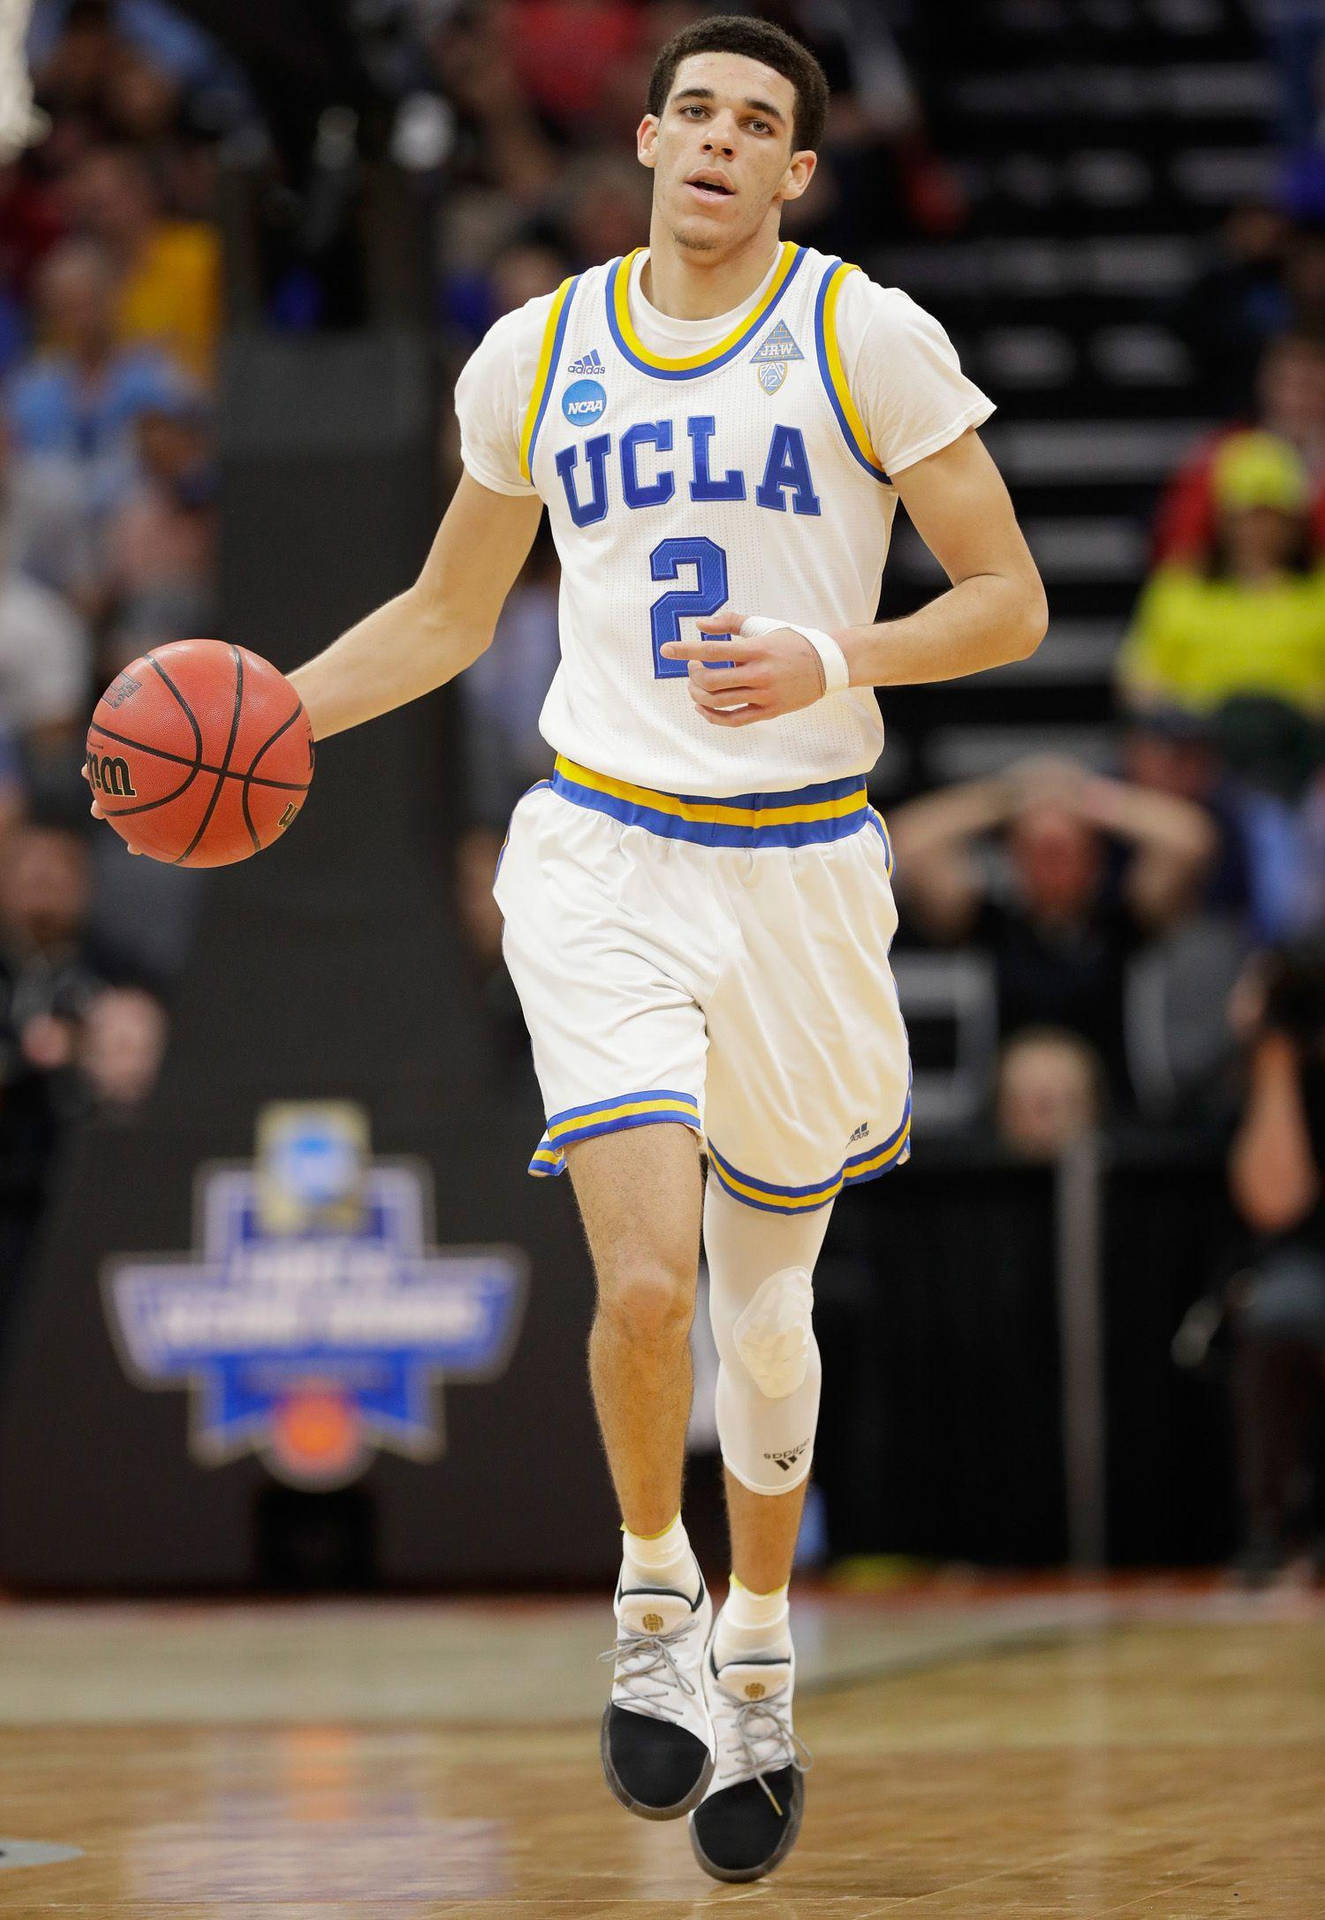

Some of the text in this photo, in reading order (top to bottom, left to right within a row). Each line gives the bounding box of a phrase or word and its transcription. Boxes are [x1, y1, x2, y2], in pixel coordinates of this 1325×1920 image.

[761, 344, 793, 356] JRW
[568, 364, 606, 375] adidas
[568, 400, 603, 415] NCAA
[555, 415, 821, 528] UCLA
[649, 536, 735, 680] 2
